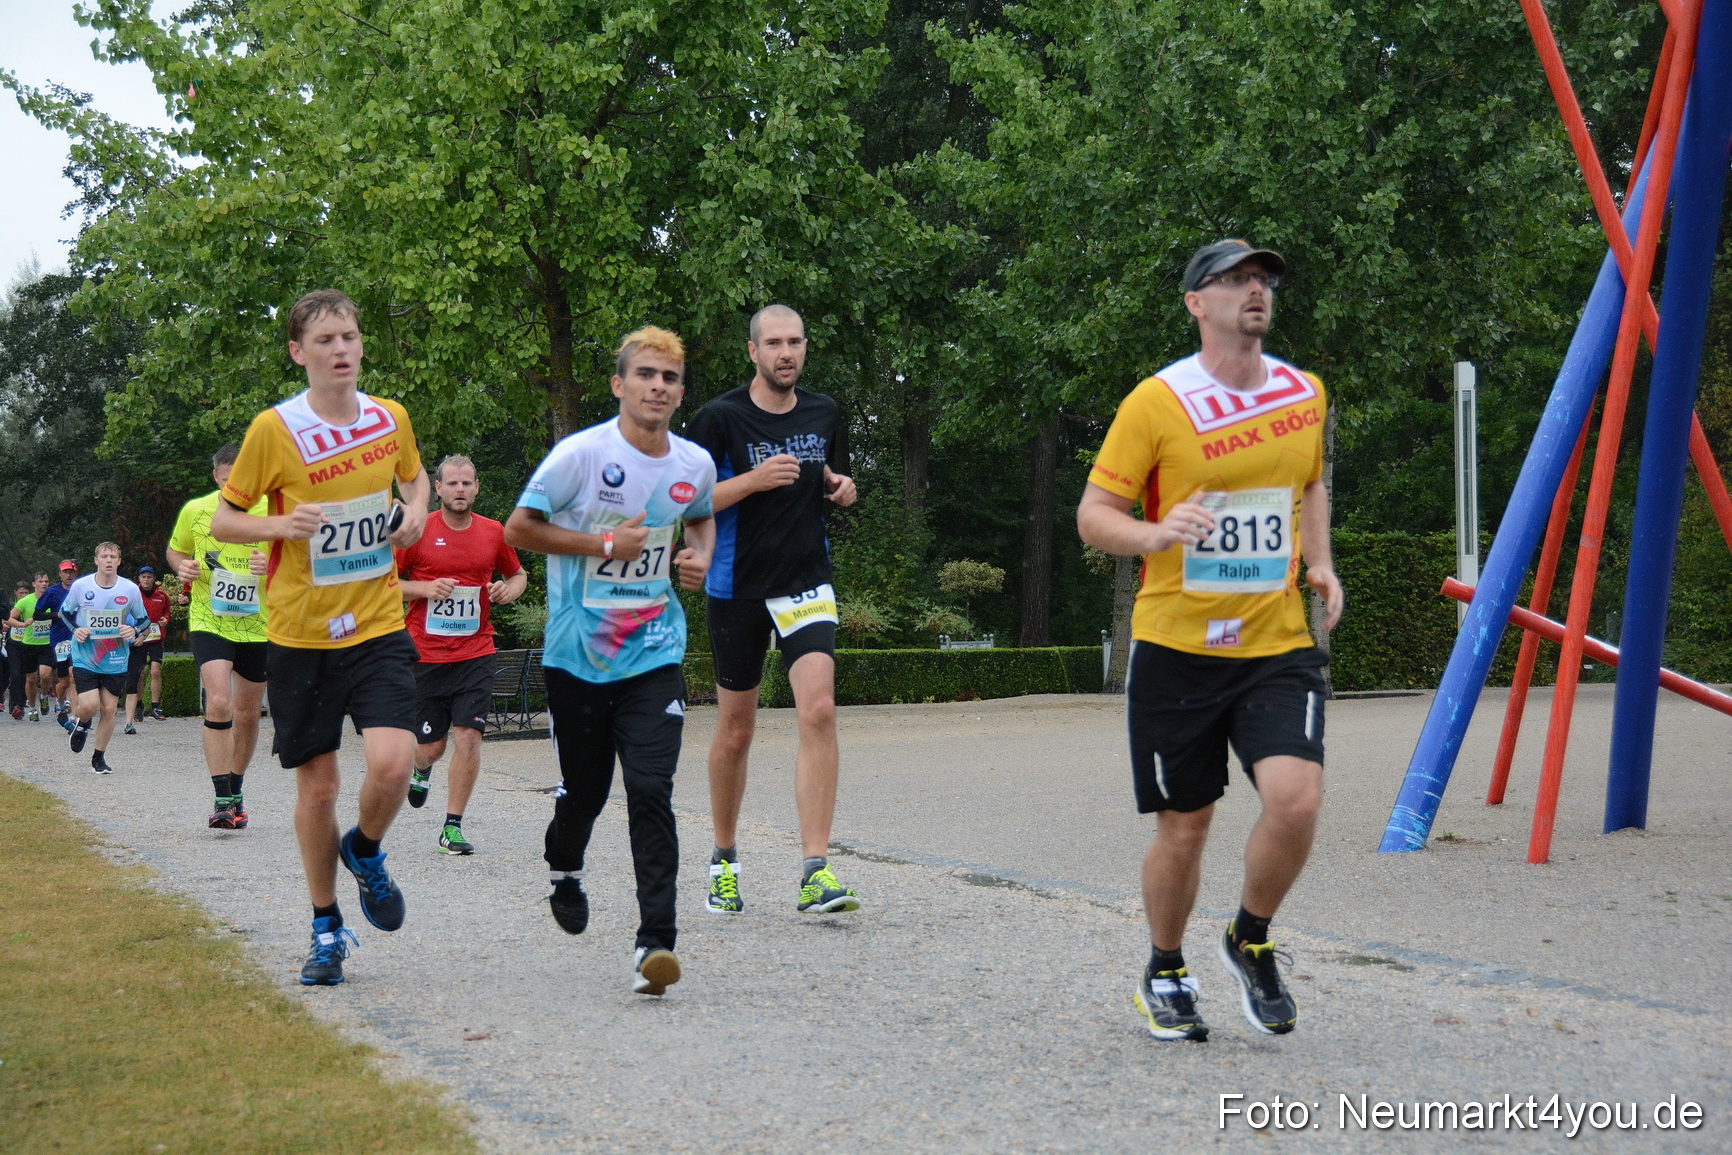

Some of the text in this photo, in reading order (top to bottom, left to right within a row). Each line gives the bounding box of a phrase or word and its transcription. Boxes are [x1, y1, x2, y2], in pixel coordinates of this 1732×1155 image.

[1201, 407, 1321, 461] MAX BÖGL
[308, 438, 400, 486] MAX BÖGL
[349, 495, 385, 512] BOCK
[599, 489, 625, 501] PARTL
[320, 512, 387, 554] 2702
[339, 554, 378, 571] Yannik
[1218, 562, 1260, 581] Ralph
[215, 580, 256, 602] 2867
[433, 598, 475, 617] 2311
[792, 603, 828, 620] Manuel
[90, 616, 119, 628] 2569
[440, 621, 466, 629] Jochen
[422, 721, 432, 734] 6
